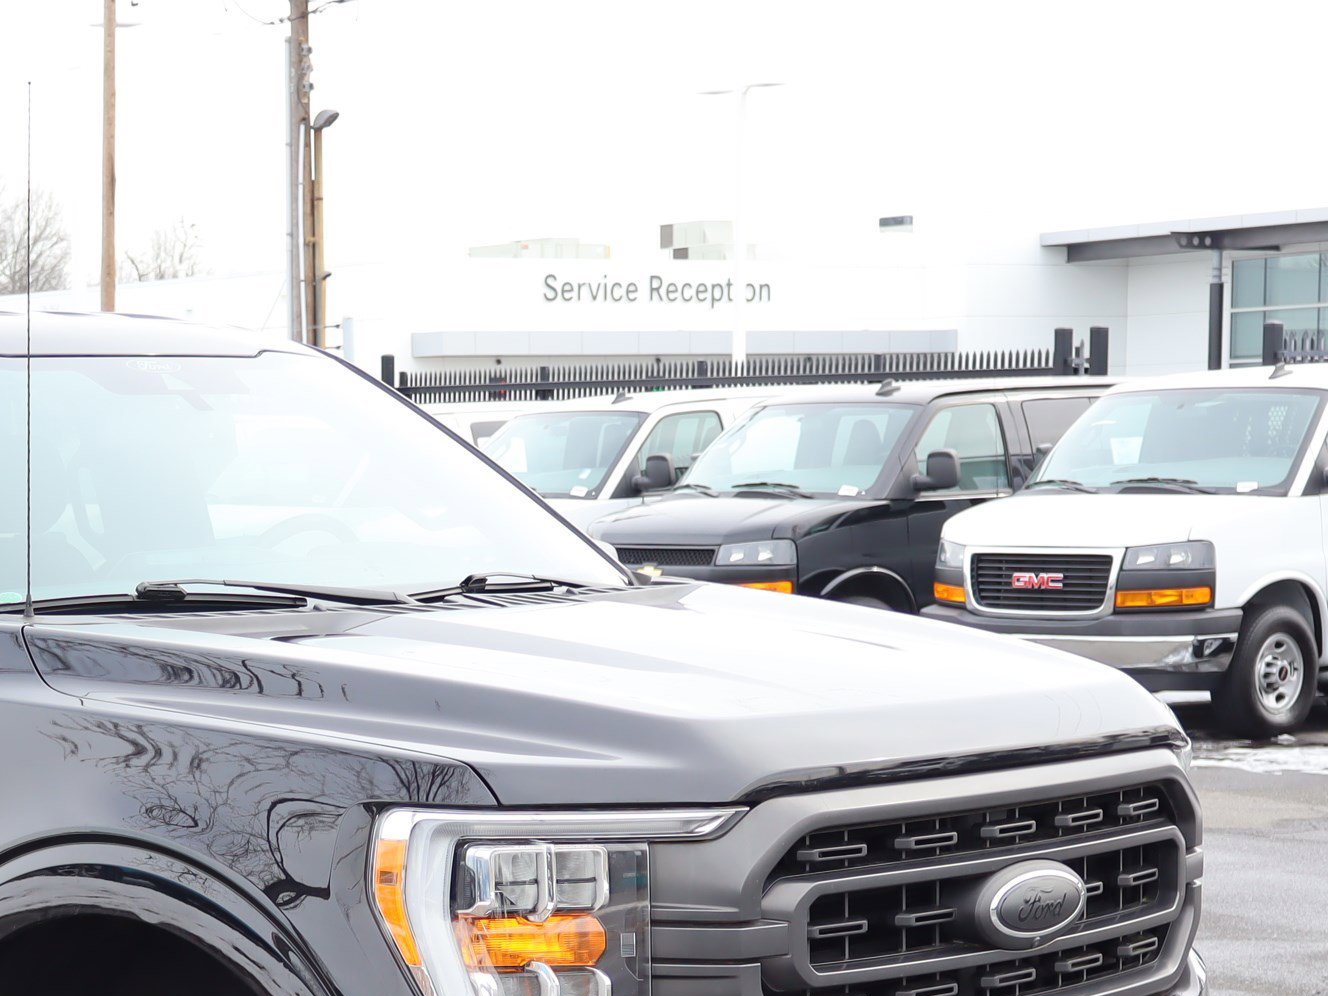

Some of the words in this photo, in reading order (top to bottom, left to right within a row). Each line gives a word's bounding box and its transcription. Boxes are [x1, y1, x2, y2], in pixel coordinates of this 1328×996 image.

[543, 274, 639, 302] Service
[648, 275, 772, 309] Recepton
[1012, 572, 1063, 589] GMC
[1018, 886, 1068, 922] Ford
